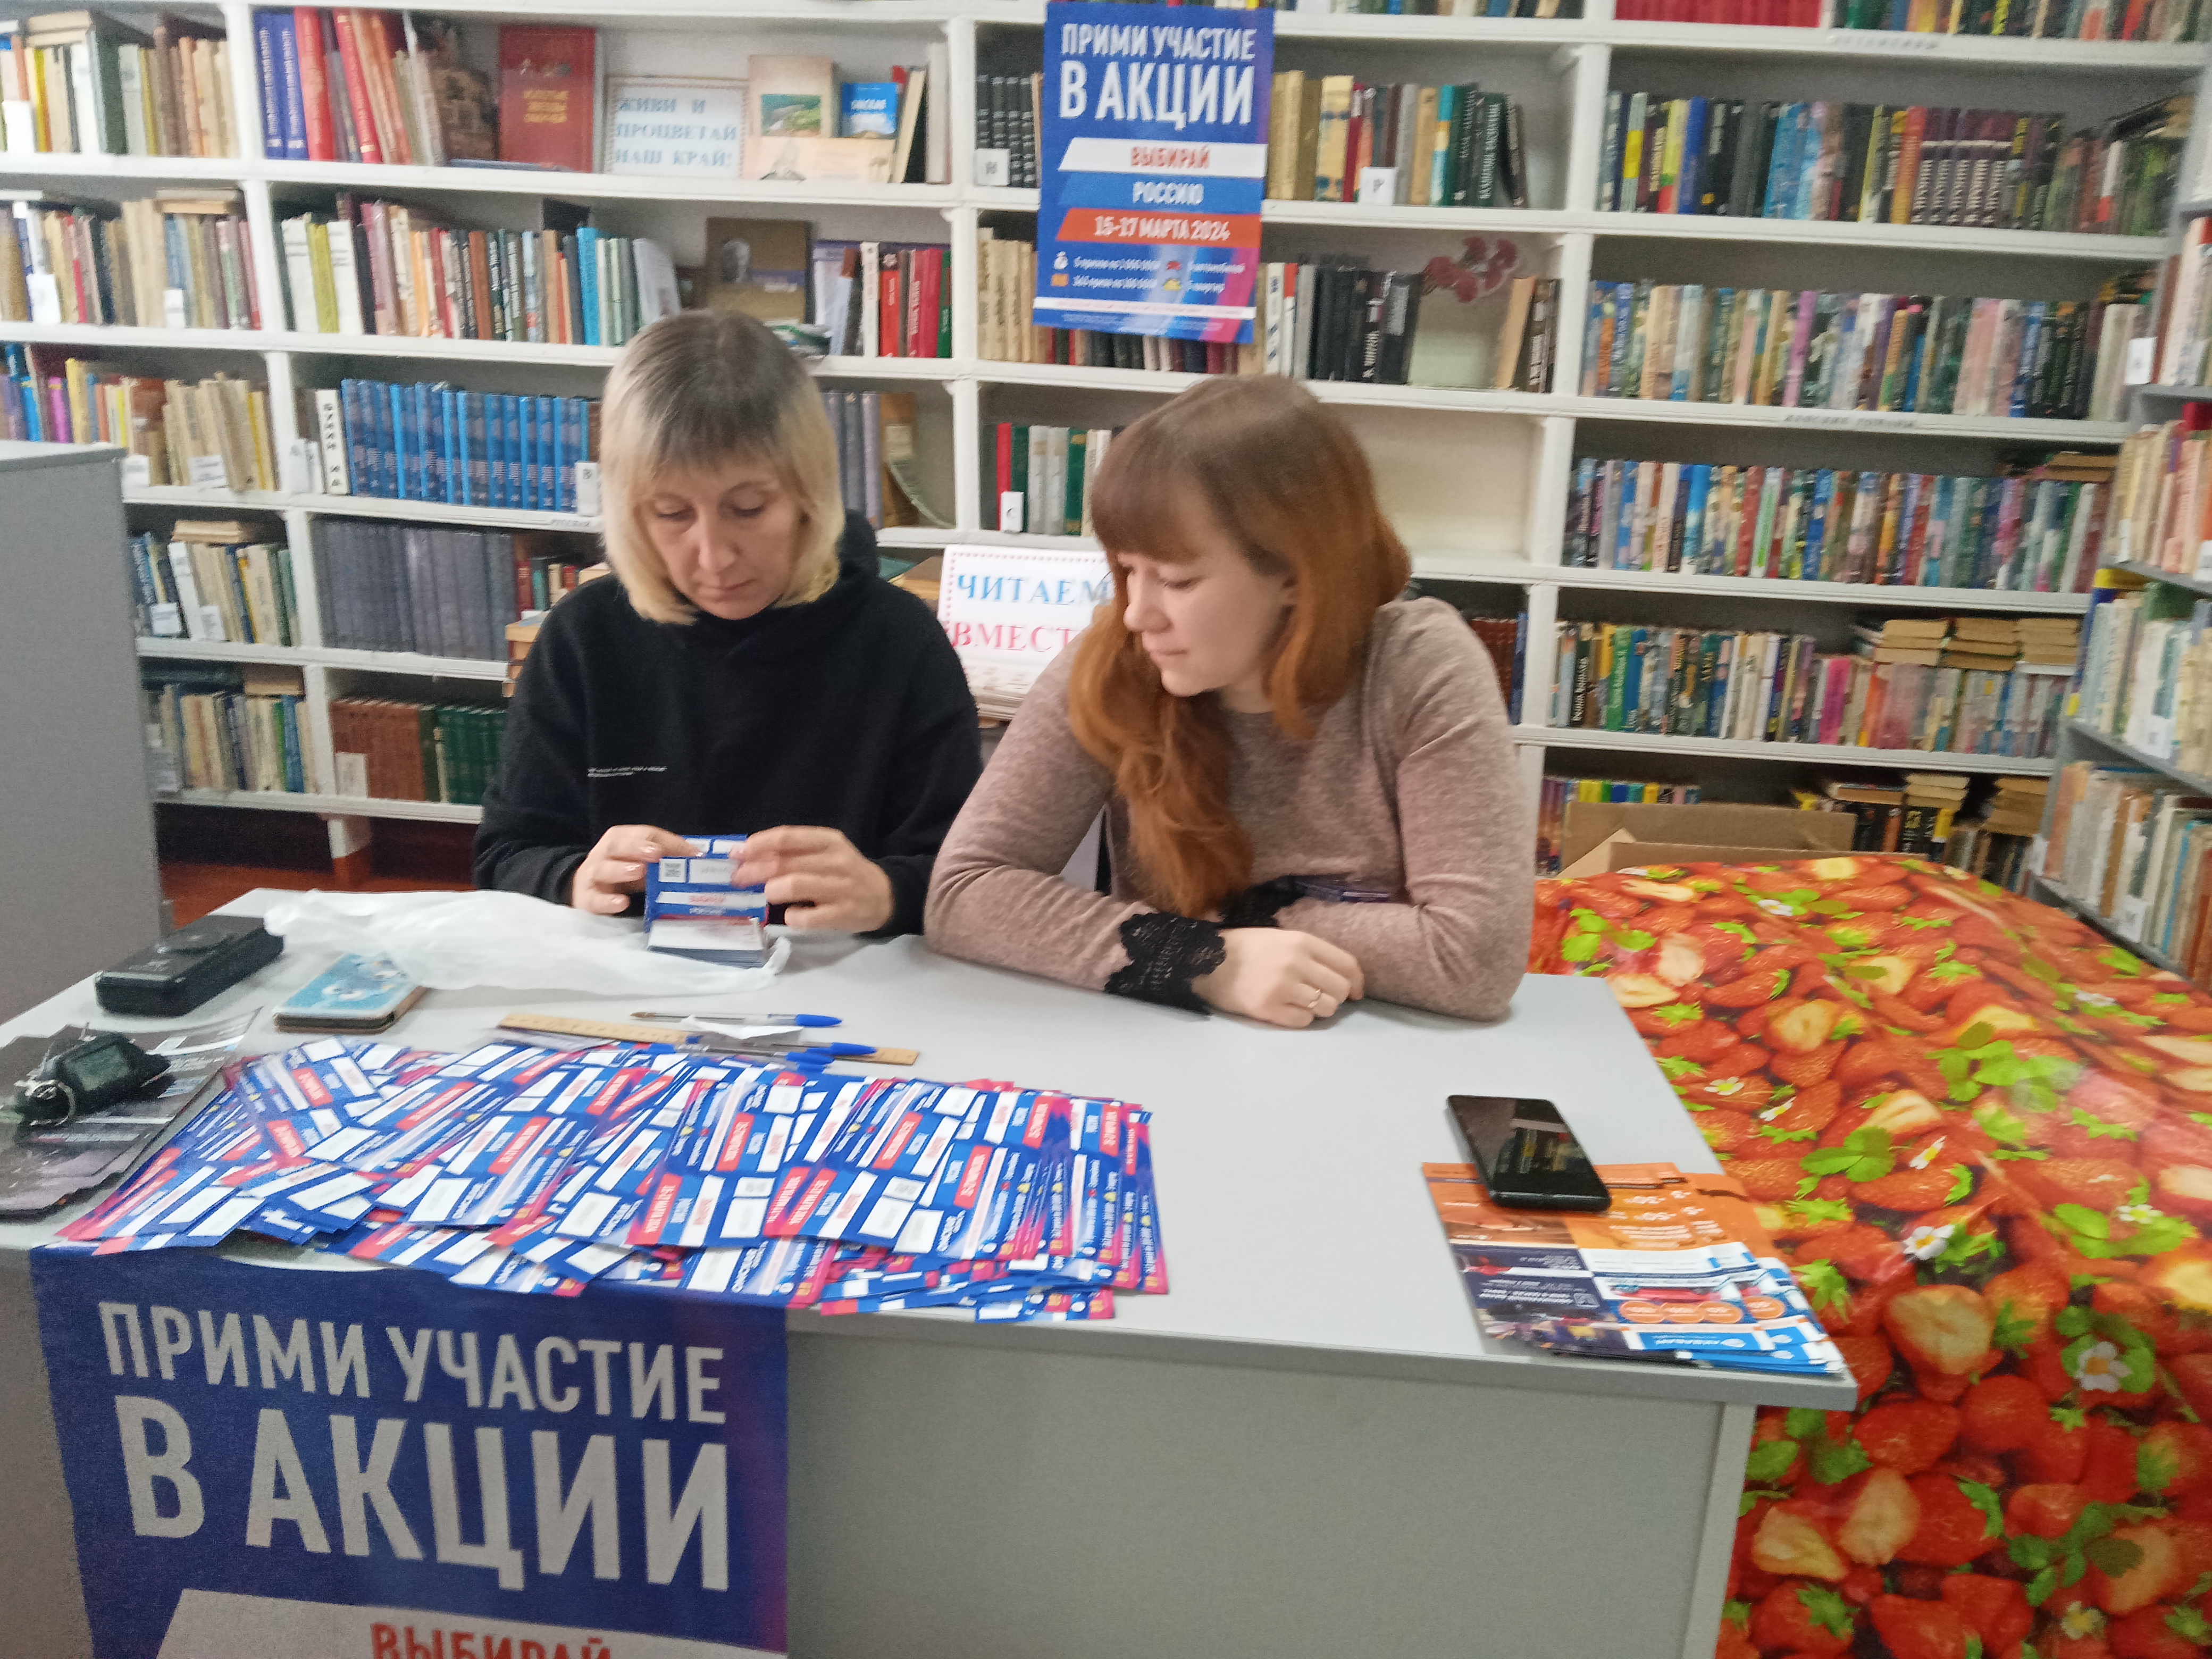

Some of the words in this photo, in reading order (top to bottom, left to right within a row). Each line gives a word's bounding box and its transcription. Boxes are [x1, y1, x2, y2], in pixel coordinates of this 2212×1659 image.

[1061, 23, 1149, 57] ПРИМИ
[1152, 26, 1257, 61] УЧАСТИЕ
[692, 99, 706, 113] И
[1059, 60, 1088, 120] В
[1095, 61, 1255, 131] АКЦИИ
[616, 123, 736, 140] ПРОЦВЕТАЙ
[616, 149, 662, 164] НАШ
[1131, 145, 1210, 169] ВЫБИРАЙ
[1094, 216, 1139, 237] 15-17
[1139, 217, 1191, 240] МАРТА
[957, 574, 1110, 606] ЧИТАЕМ
[951, 622, 1084, 652] ВМЕСТ
[98, 1301, 371, 1400] ПРИМИ
[387, 1326, 726, 1425] УЧАСТИЕ
[114, 1395, 207, 1539] В
[245, 1407, 730, 1592] АКЦИИ
